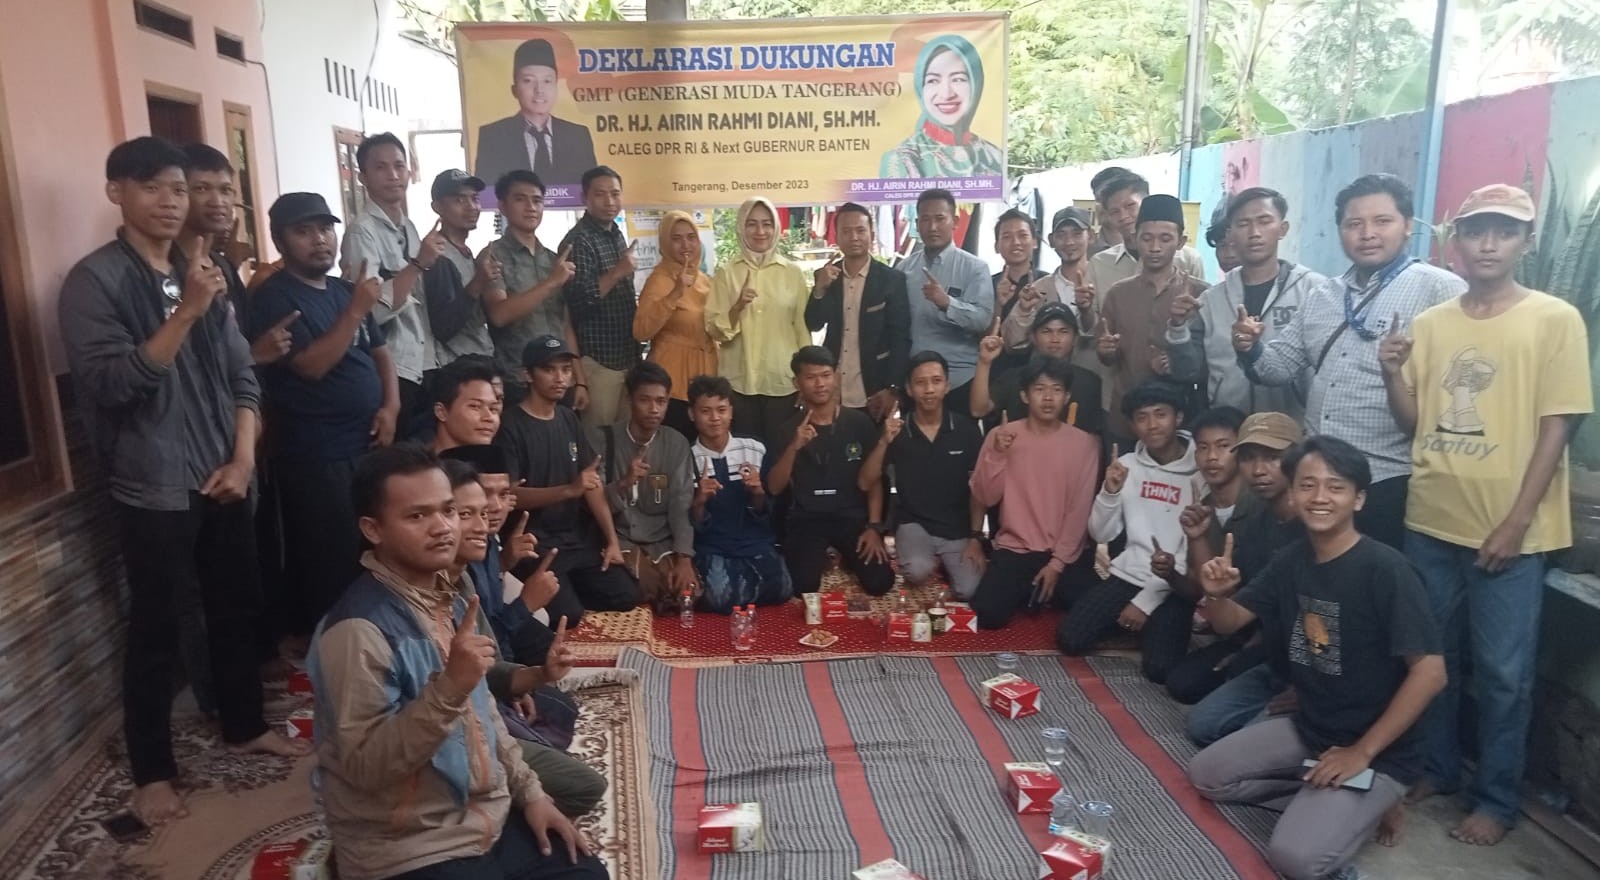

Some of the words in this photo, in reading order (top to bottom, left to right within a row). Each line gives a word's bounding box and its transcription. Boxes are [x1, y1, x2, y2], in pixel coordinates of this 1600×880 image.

[577, 46, 734, 73] DEKLARASI
[739, 42, 896, 71] DUKUNGAN
[573, 87, 613, 102] GMT
[618, 85, 718, 103] (GENERASI
[723, 84, 777, 99] MUDA
[782, 81, 902, 98] TANGERANG)
[596, 114, 623, 132] DR.
[628, 114, 652, 132] HJ.
[658, 113, 703, 131] AIRIN
[708, 112, 763, 130] RAHMI
[767, 111, 819, 132] DIANI,
[823, 109, 881, 128] SH.MH.
[608, 142, 652, 155] CALEG
[655, 142, 681, 155] DPR
[685, 142, 697, 154] RI
[700, 141, 709, 154] &
[713, 141, 740, 154] Next
[743, 139, 815, 153] GUBERNUR
[818, 138, 870, 152] BANTEN
[672, 182, 729, 193] Tangerang,
[731, 181, 783, 190] Desember
[786, 180, 809, 190] 2023
[883, 181, 907, 190] AIRIN
[908, 180, 936, 190] RAHMI
